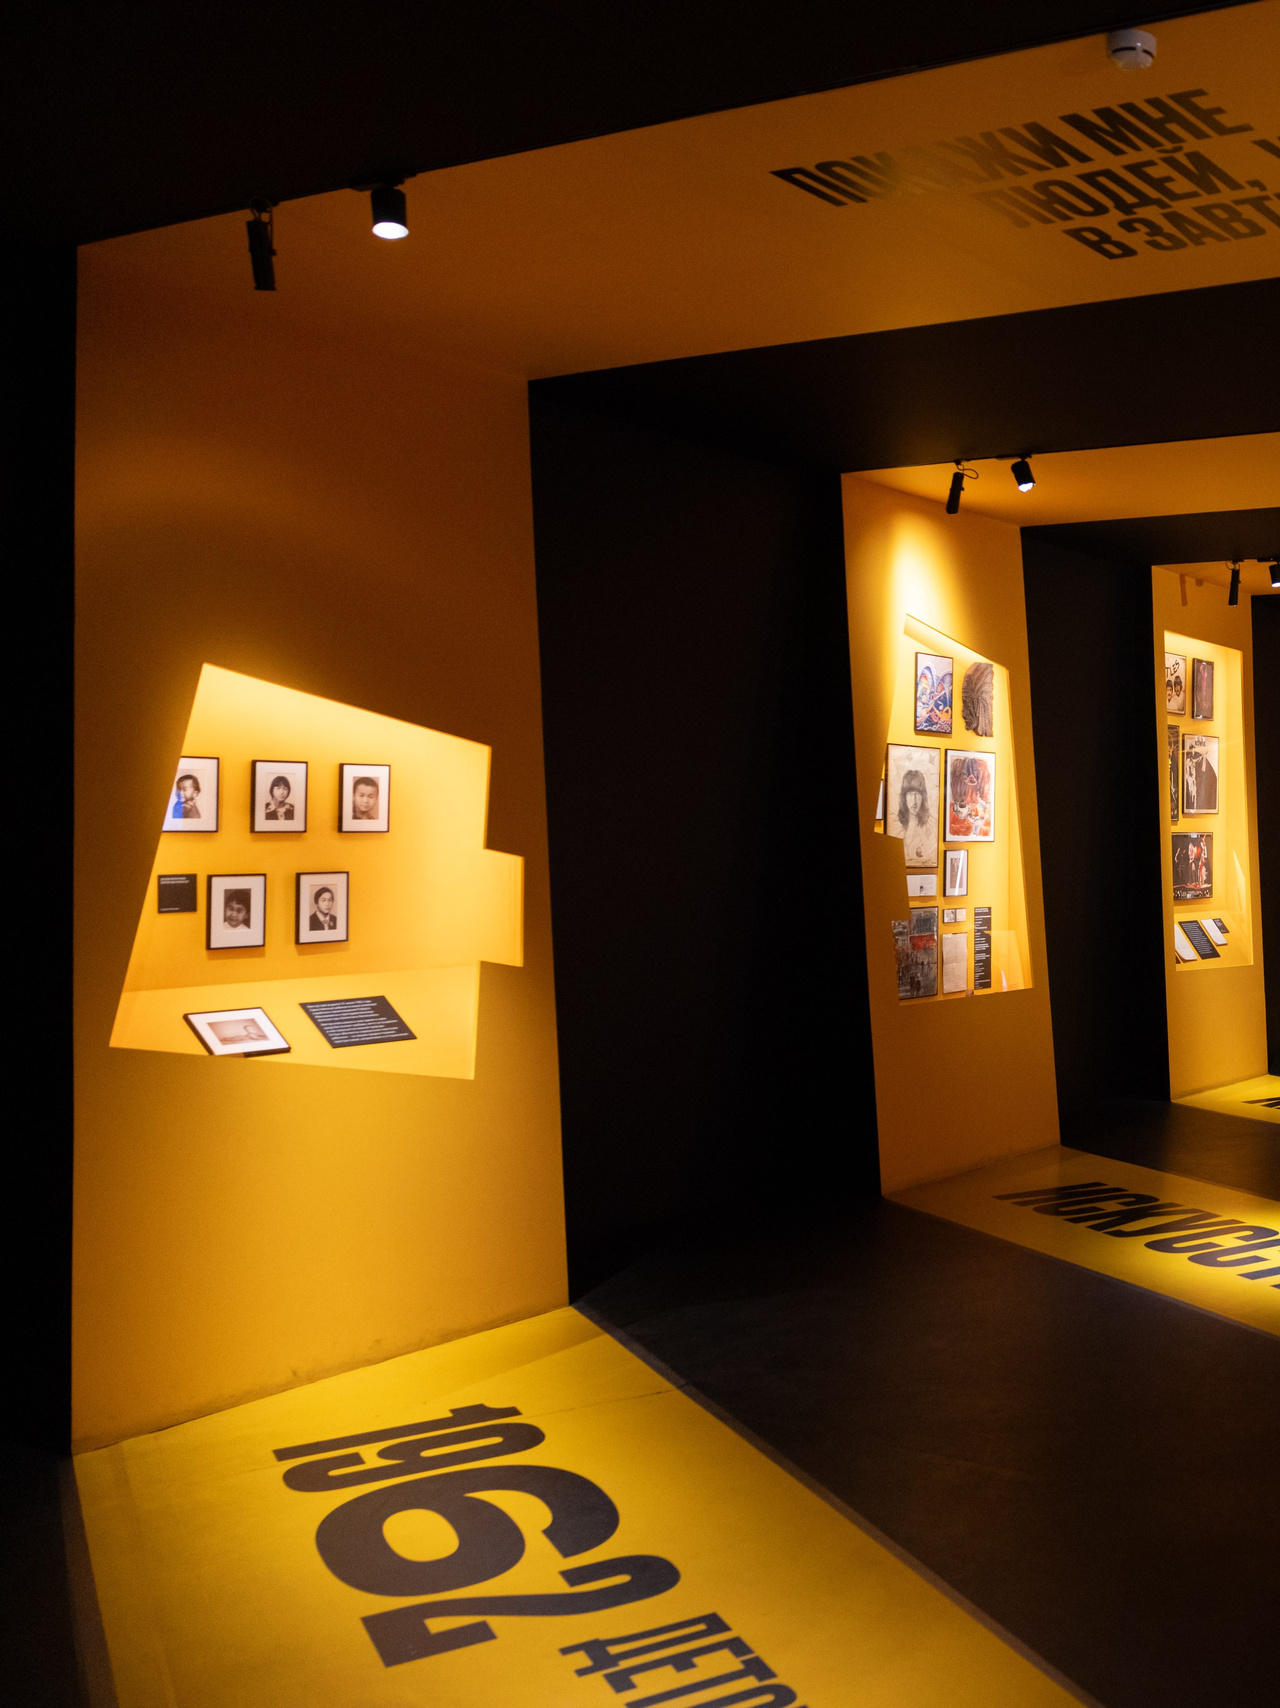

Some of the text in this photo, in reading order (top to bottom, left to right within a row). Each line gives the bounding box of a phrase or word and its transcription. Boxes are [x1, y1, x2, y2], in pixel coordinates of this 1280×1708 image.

[1058, 88, 1254, 156] МНЕ
[970, 144, 1265, 229] ЛЮДЕЙ,
[1061, 226, 1139, 260] В
[272, 1402, 682, 1669] 1962
